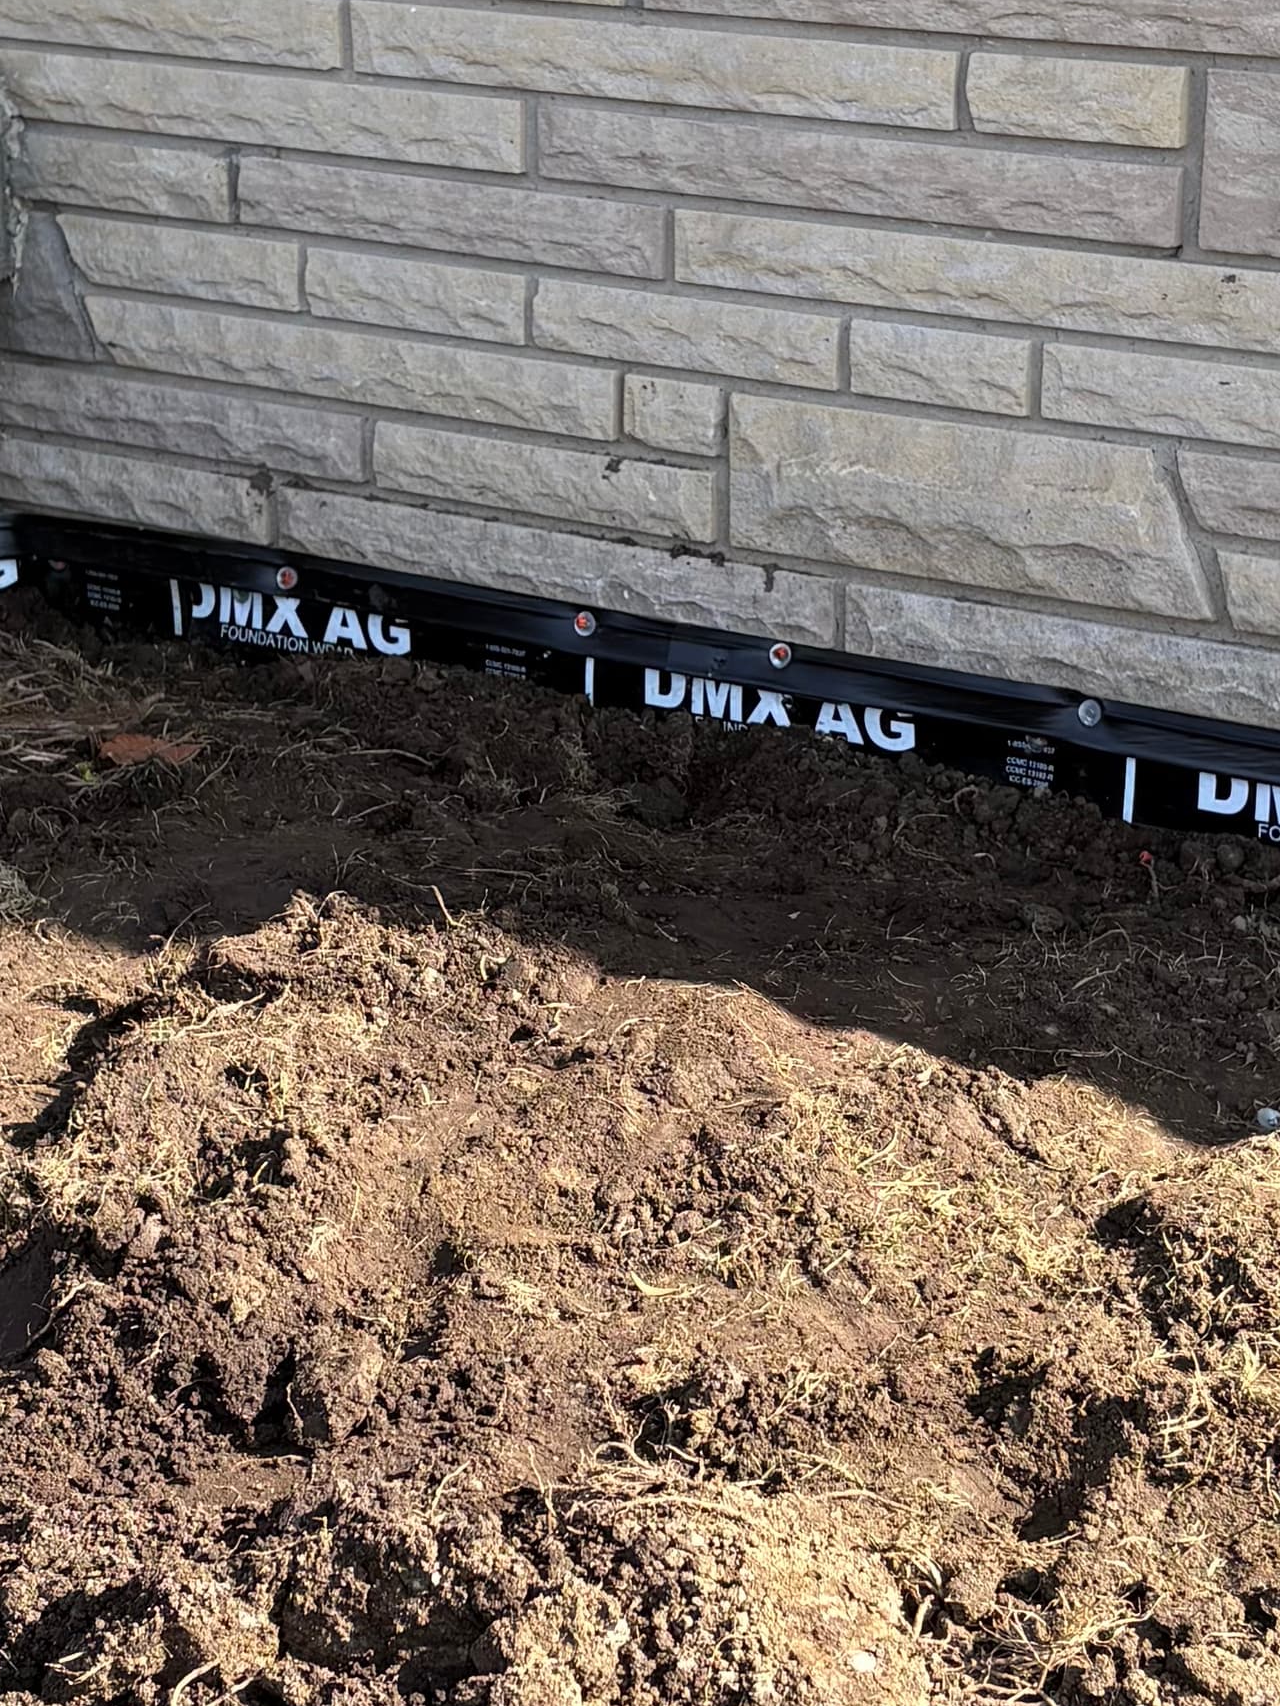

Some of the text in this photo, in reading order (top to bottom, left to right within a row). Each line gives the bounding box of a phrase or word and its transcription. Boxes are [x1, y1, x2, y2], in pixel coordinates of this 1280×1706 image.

[221, 624, 308, 653] FOUNDATION
[323, 606, 411, 656] AG
[644, 668, 916, 752] DMX AG
